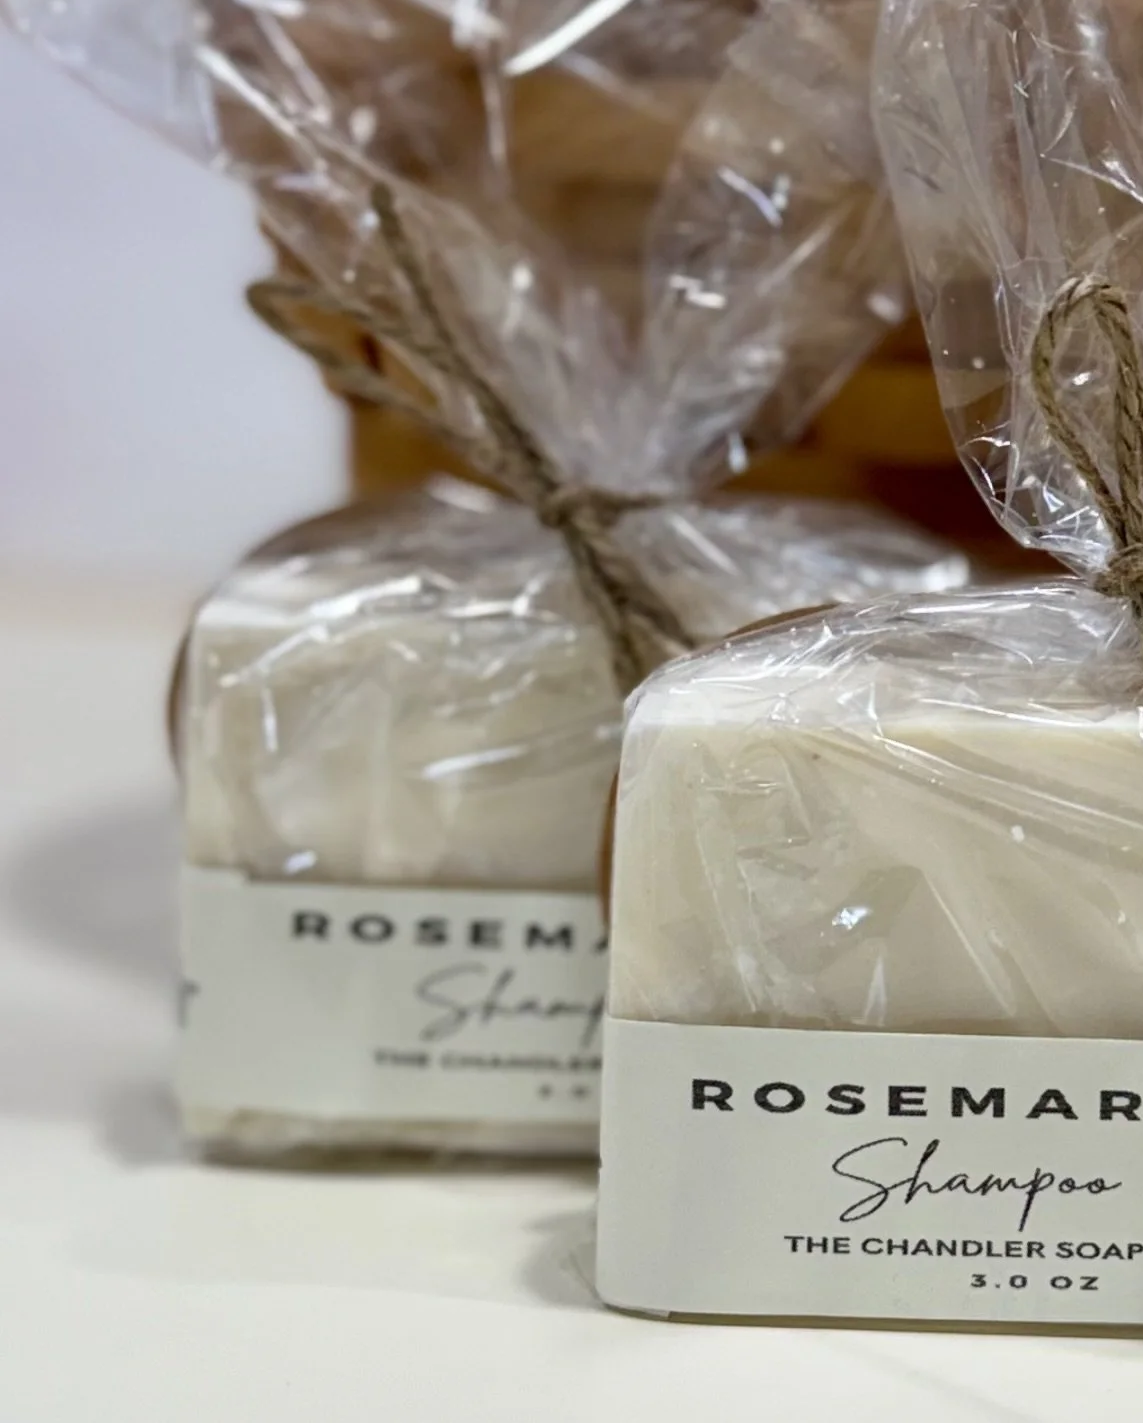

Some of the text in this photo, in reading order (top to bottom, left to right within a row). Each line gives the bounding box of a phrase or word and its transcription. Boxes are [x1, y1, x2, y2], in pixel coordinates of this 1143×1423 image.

[291, 911, 608, 952] ROSEM
[832, 1136, 1123, 1233] Shampoo
[783, 1235, 851, 1255] THE
[860, 1237, 1046, 1260] CHANDLER
[970, 1273, 1100, 1291] 3.0 OZ
